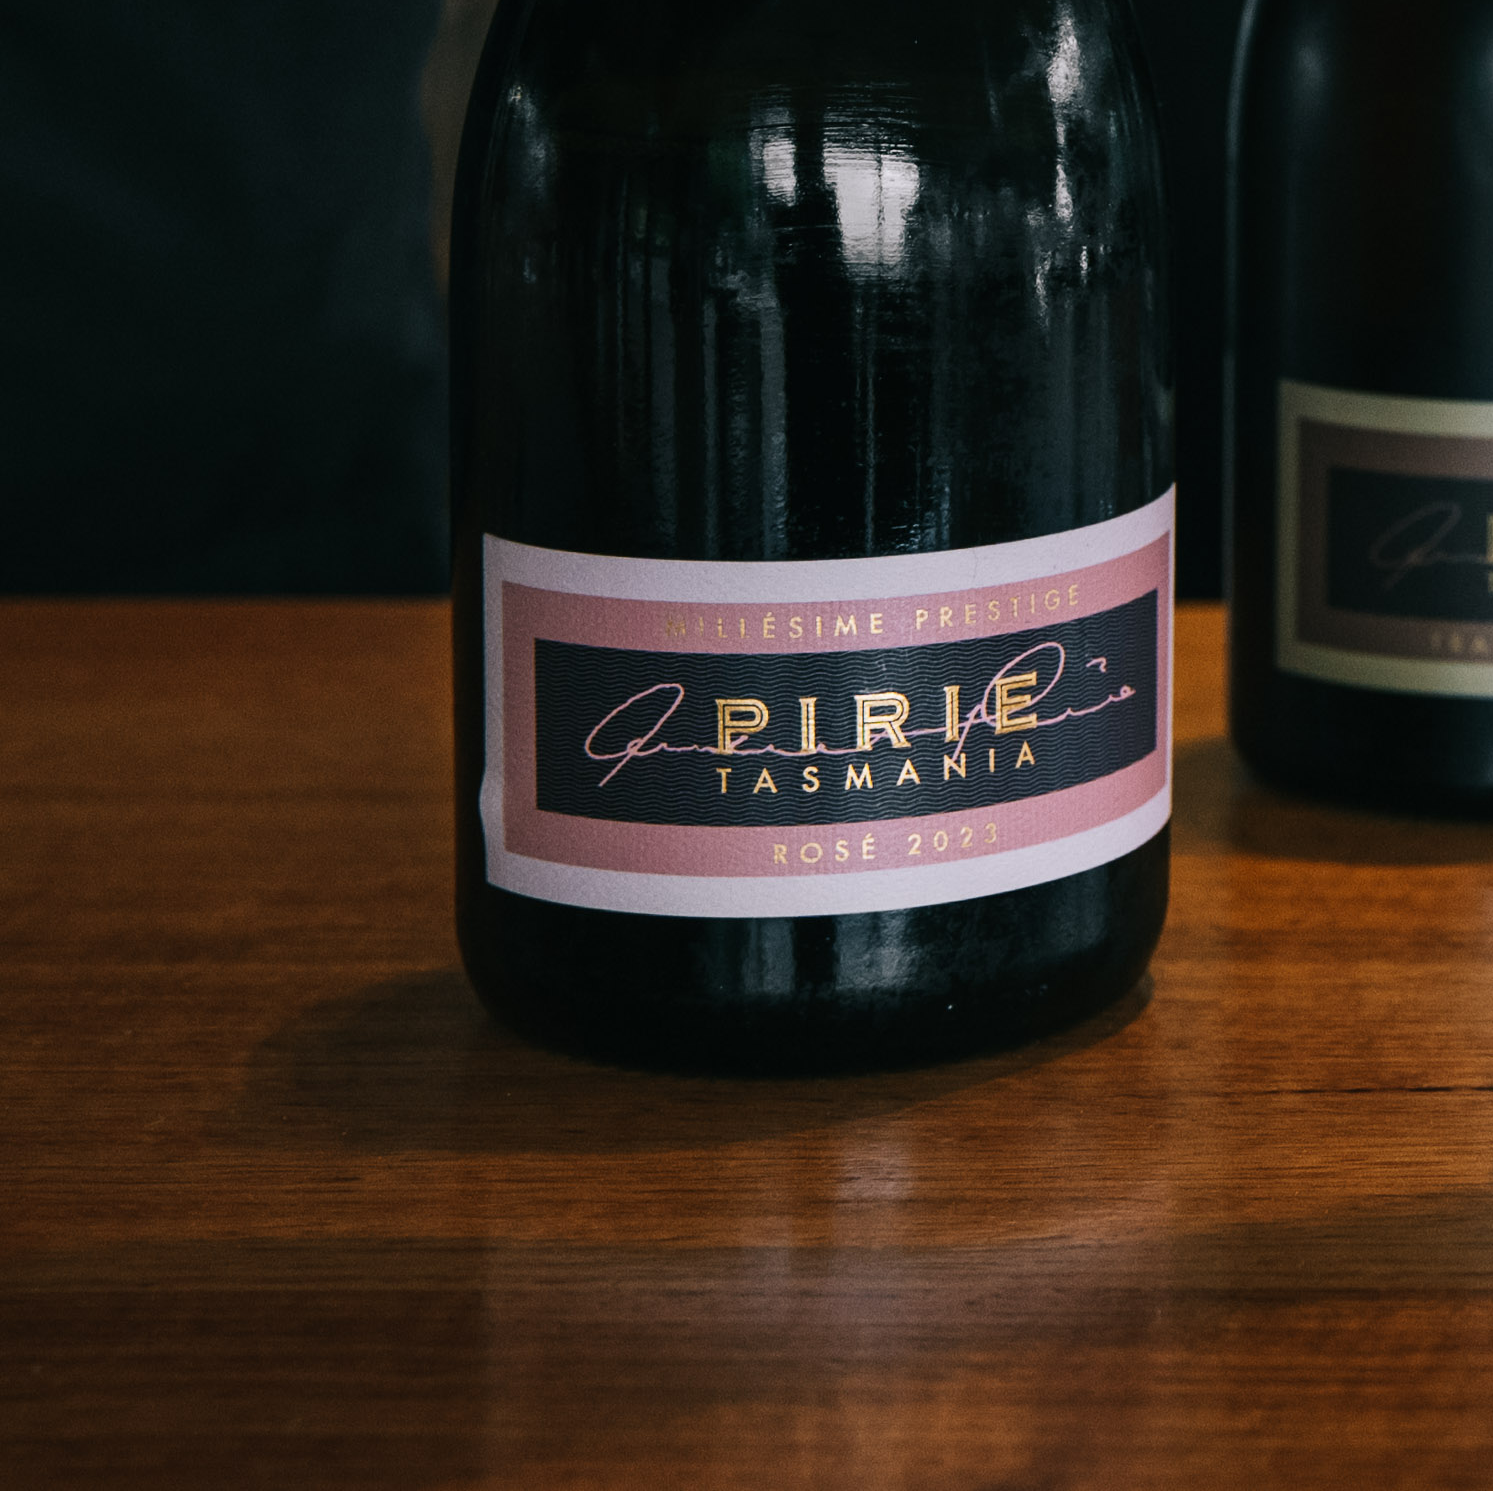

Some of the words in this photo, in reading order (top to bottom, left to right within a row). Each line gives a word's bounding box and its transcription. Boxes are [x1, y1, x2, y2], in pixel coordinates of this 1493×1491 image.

[665, 611, 885, 640] MILLÉSIME
[915, 584, 1080, 631] PRESTIGE
[715, 671, 1038, 755] PIRIE
[715, 740, 1036, 794] TASMANIA
[773, 832, 876, 864] ROSÉ
[907, 822, 998, 856] 2023
